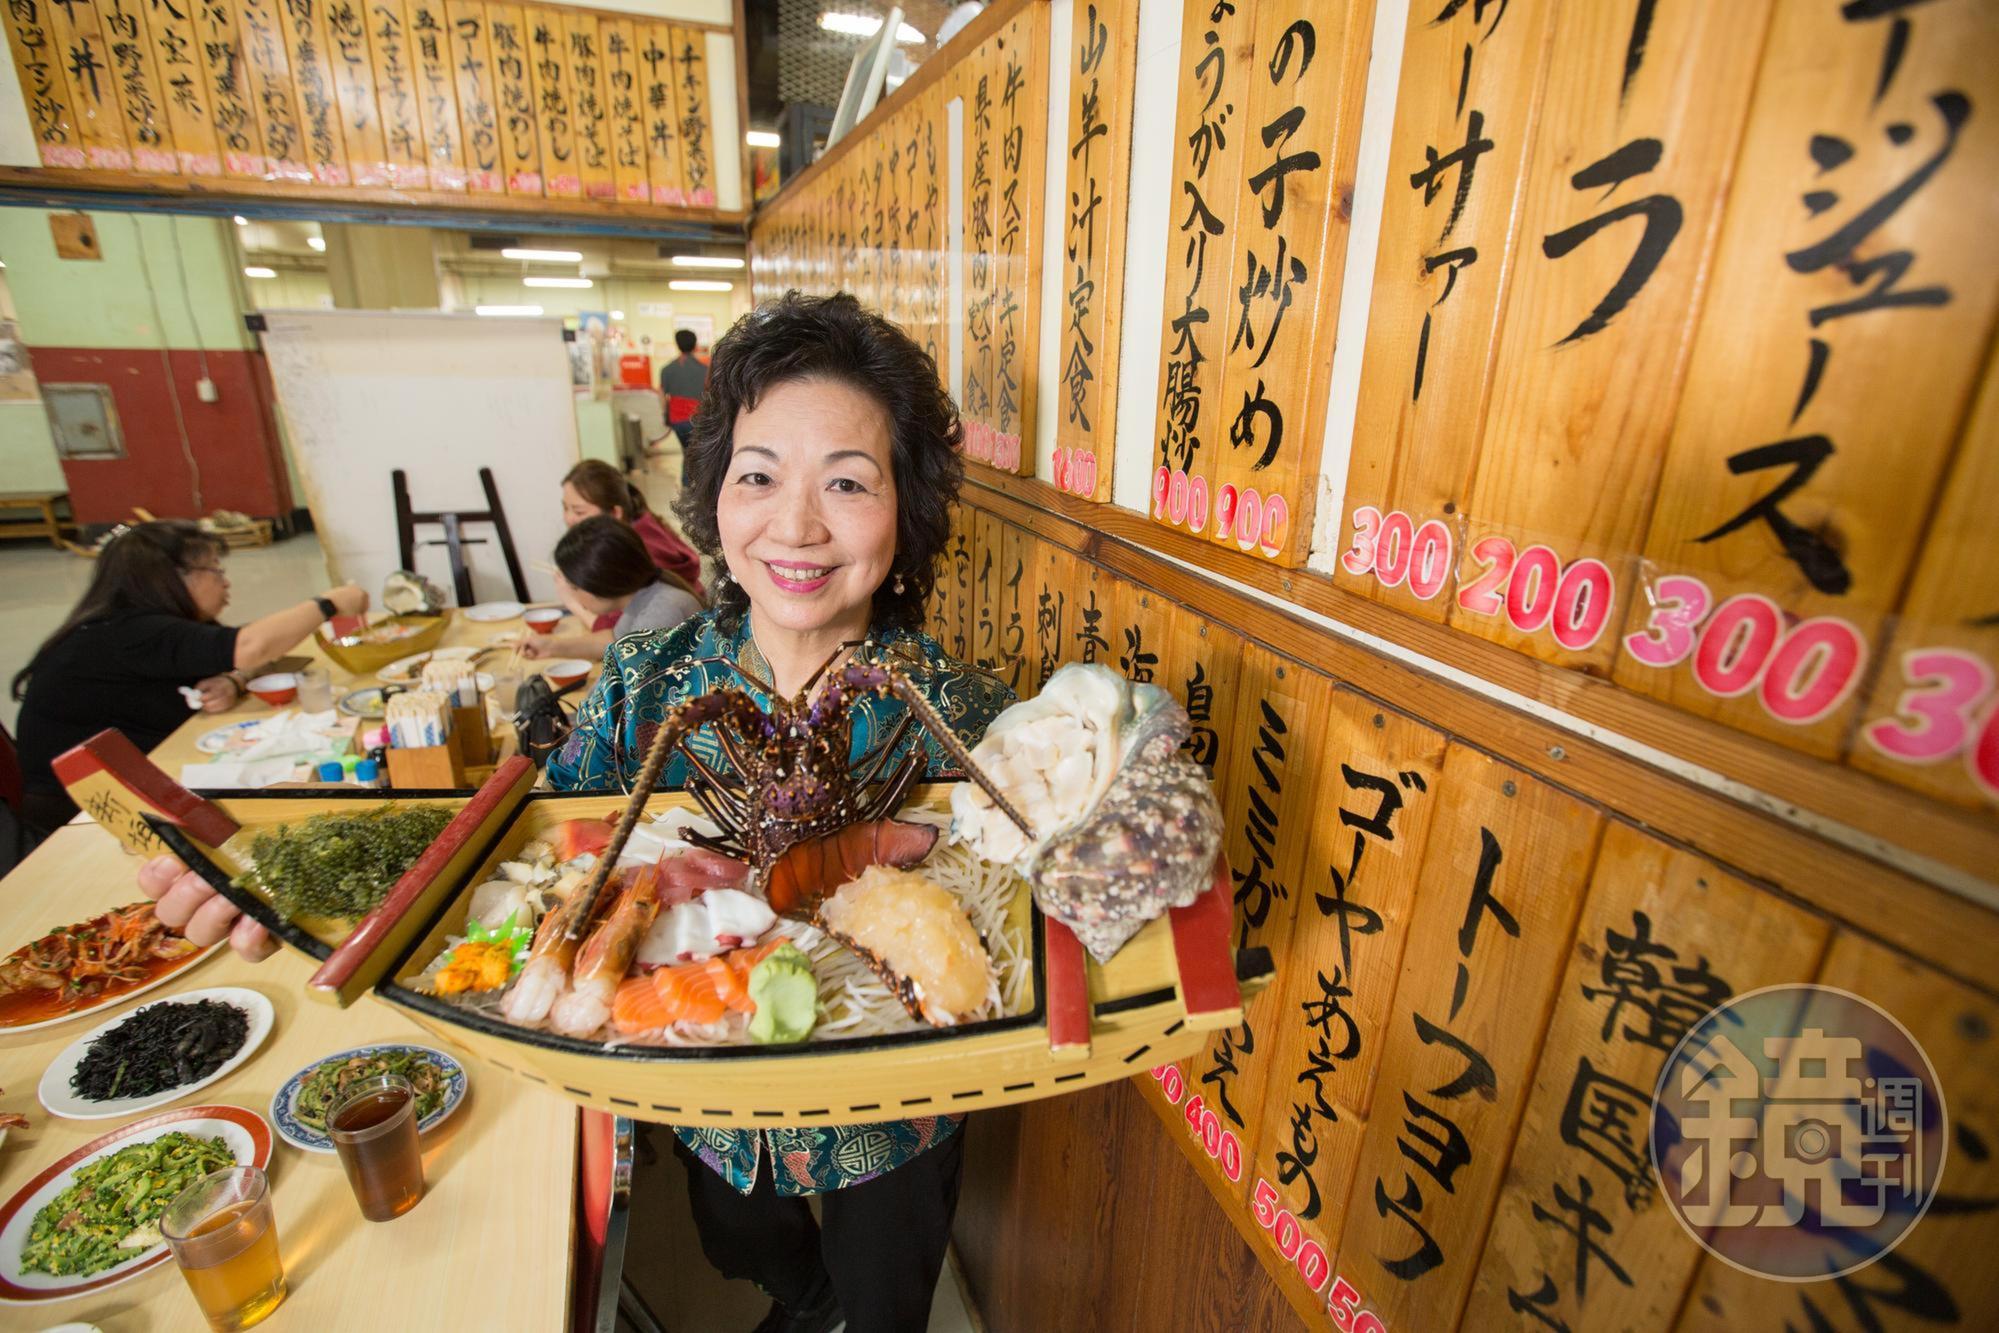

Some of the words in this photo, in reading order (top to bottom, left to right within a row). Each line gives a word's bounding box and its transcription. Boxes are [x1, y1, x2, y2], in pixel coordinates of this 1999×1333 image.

[1063, 3, 1108, 433] 山羊汁定食
[1687, 0, 1974, 596] ージュース
[1152, 465, 1209, 534] 900
[1216, 482, 1289, 559] 900
[1341, 505, 1454, 600] 300
[1457, 535, 1615, 651] 200
[1623, 574, 1869, 726] 300
[1184, 1094, 1242, 1183] 400
[1251, 1177, 1330, 1293] 500
